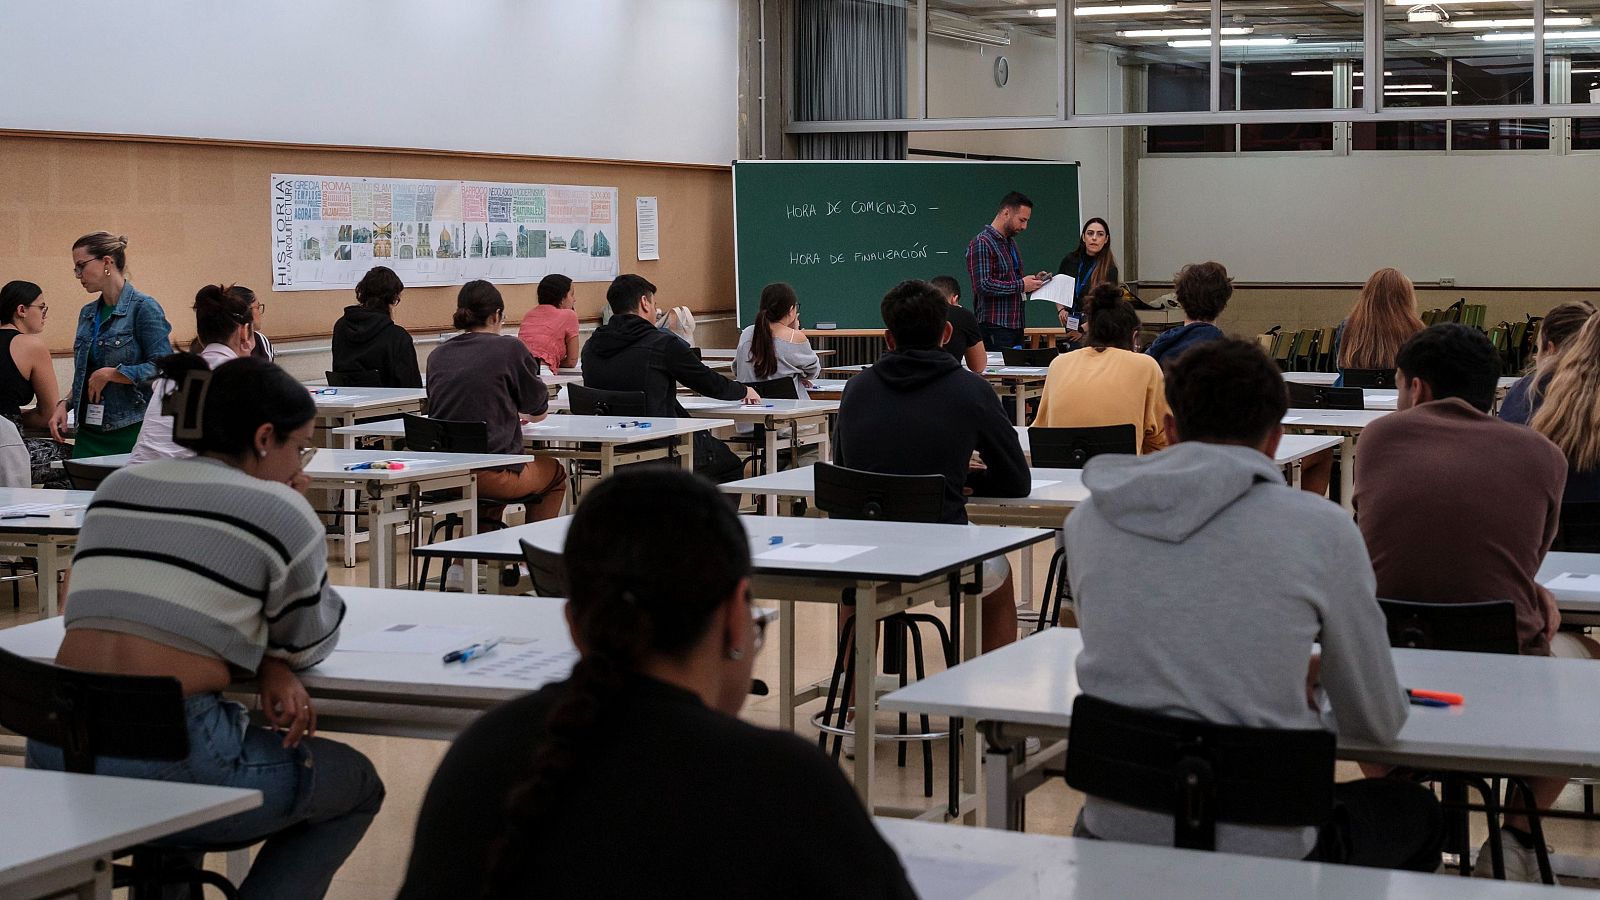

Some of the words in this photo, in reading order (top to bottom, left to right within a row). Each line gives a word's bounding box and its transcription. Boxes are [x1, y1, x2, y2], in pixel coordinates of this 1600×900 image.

[294, 180, 320, 190] GRECIA
[321, 181, 352, 191] ROMA
[461, 185, 488, 194] BARROCO
[513, 187, 546, 197] MODERNISMO
[786, 203, 817, 219] HORA
[826, 201, 842, 216] DE
[851, 200, 917, 216] COMIENZO
[284, 180, 294, 260] ARQUITECTURA
[275, 180, 287, 286] HISTORIA
[790, 252, 821, 265] HORA
[829, 253, 846, 264] DE
[854, 242, 929, 262] FINALIZACIÓN
